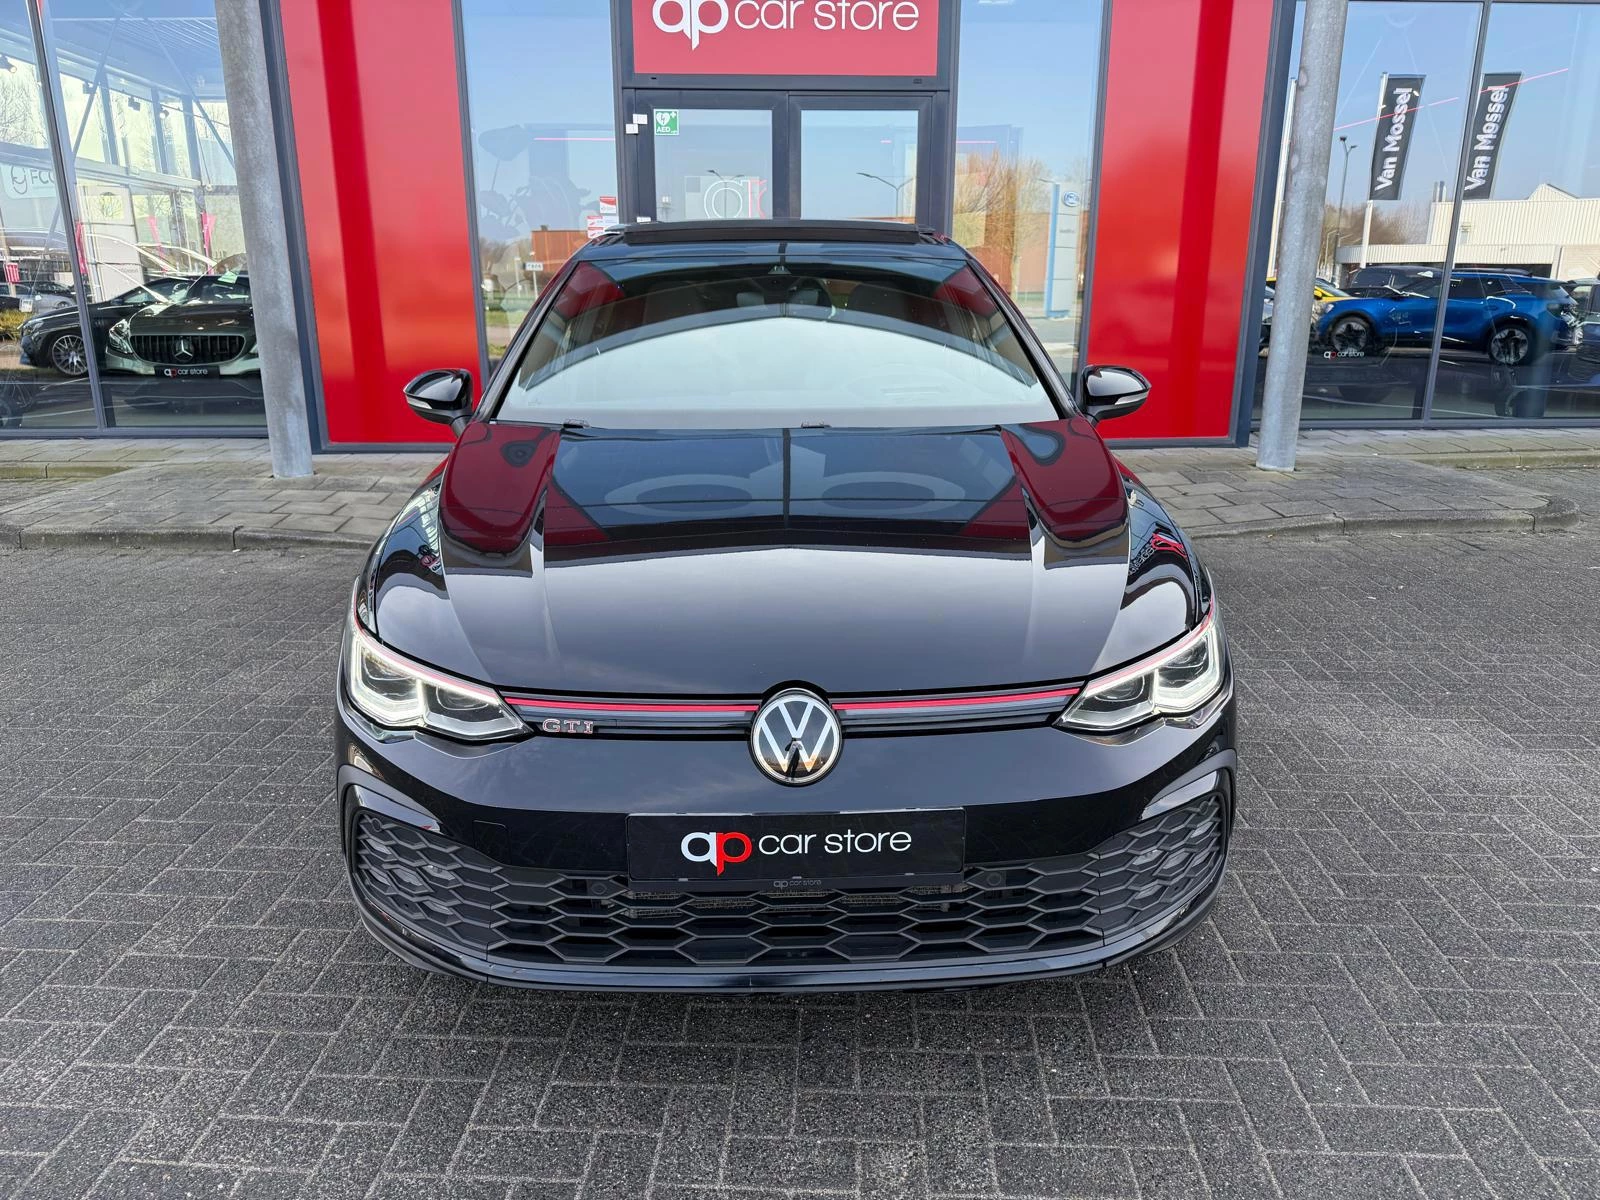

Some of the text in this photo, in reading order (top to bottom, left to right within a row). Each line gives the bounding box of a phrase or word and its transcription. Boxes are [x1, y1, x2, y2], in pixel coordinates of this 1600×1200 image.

[734, 0, 804, 30] car
[813, 0, 919, 31] store
[1374, 87, 1413, 191] Van Mossel
[1464, 85, 1509, 191] Van Mossel
[542, 718, 594, 734] GTI
[758, 834, 817, 856] car
[824, 829, 912, 855] store
